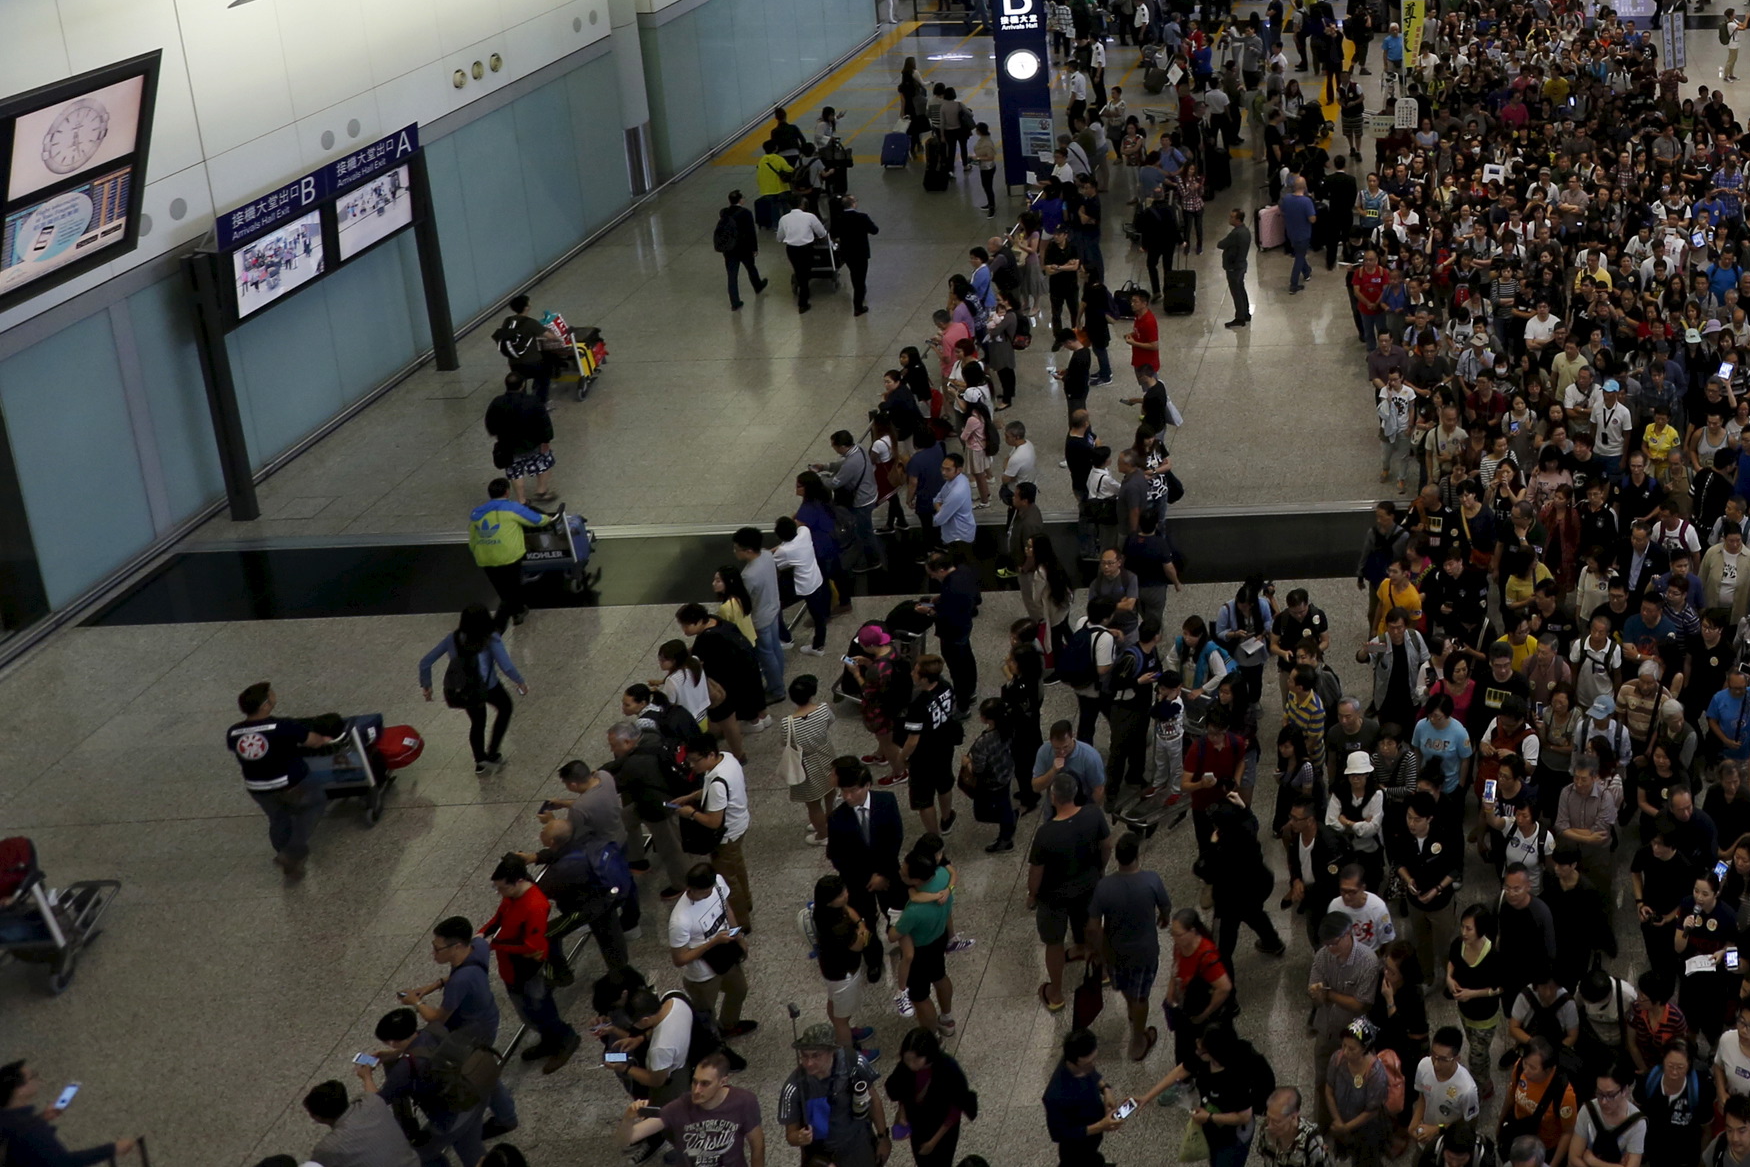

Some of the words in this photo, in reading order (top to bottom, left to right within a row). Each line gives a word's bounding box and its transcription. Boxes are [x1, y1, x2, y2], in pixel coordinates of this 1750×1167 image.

[1000, 14, 1038, 25] 接機大堂
[1001, 23, 1025, 31] Arrivals
[336, 139, 394, 177] 接機大堂出口
[396, 130, 412, 158] A
[337, 169, 361, 188] Arrivals
[361, 163, 374, 176] Hall
[374, 158, 387, 170] Exit
[232, 186, 299, 229] 接機大堂出口
[301, 176, 316, 206] B
[232, 220, 260, 241] Arrivals
[261, 211, 276, 225] Hall
[276, 206, 291, 219] Exit
[526, 550, 563, 560] KOHLER
[702, 1119, 719, 1129] YORK
[683, 1129, 736, 1155] Varsity
